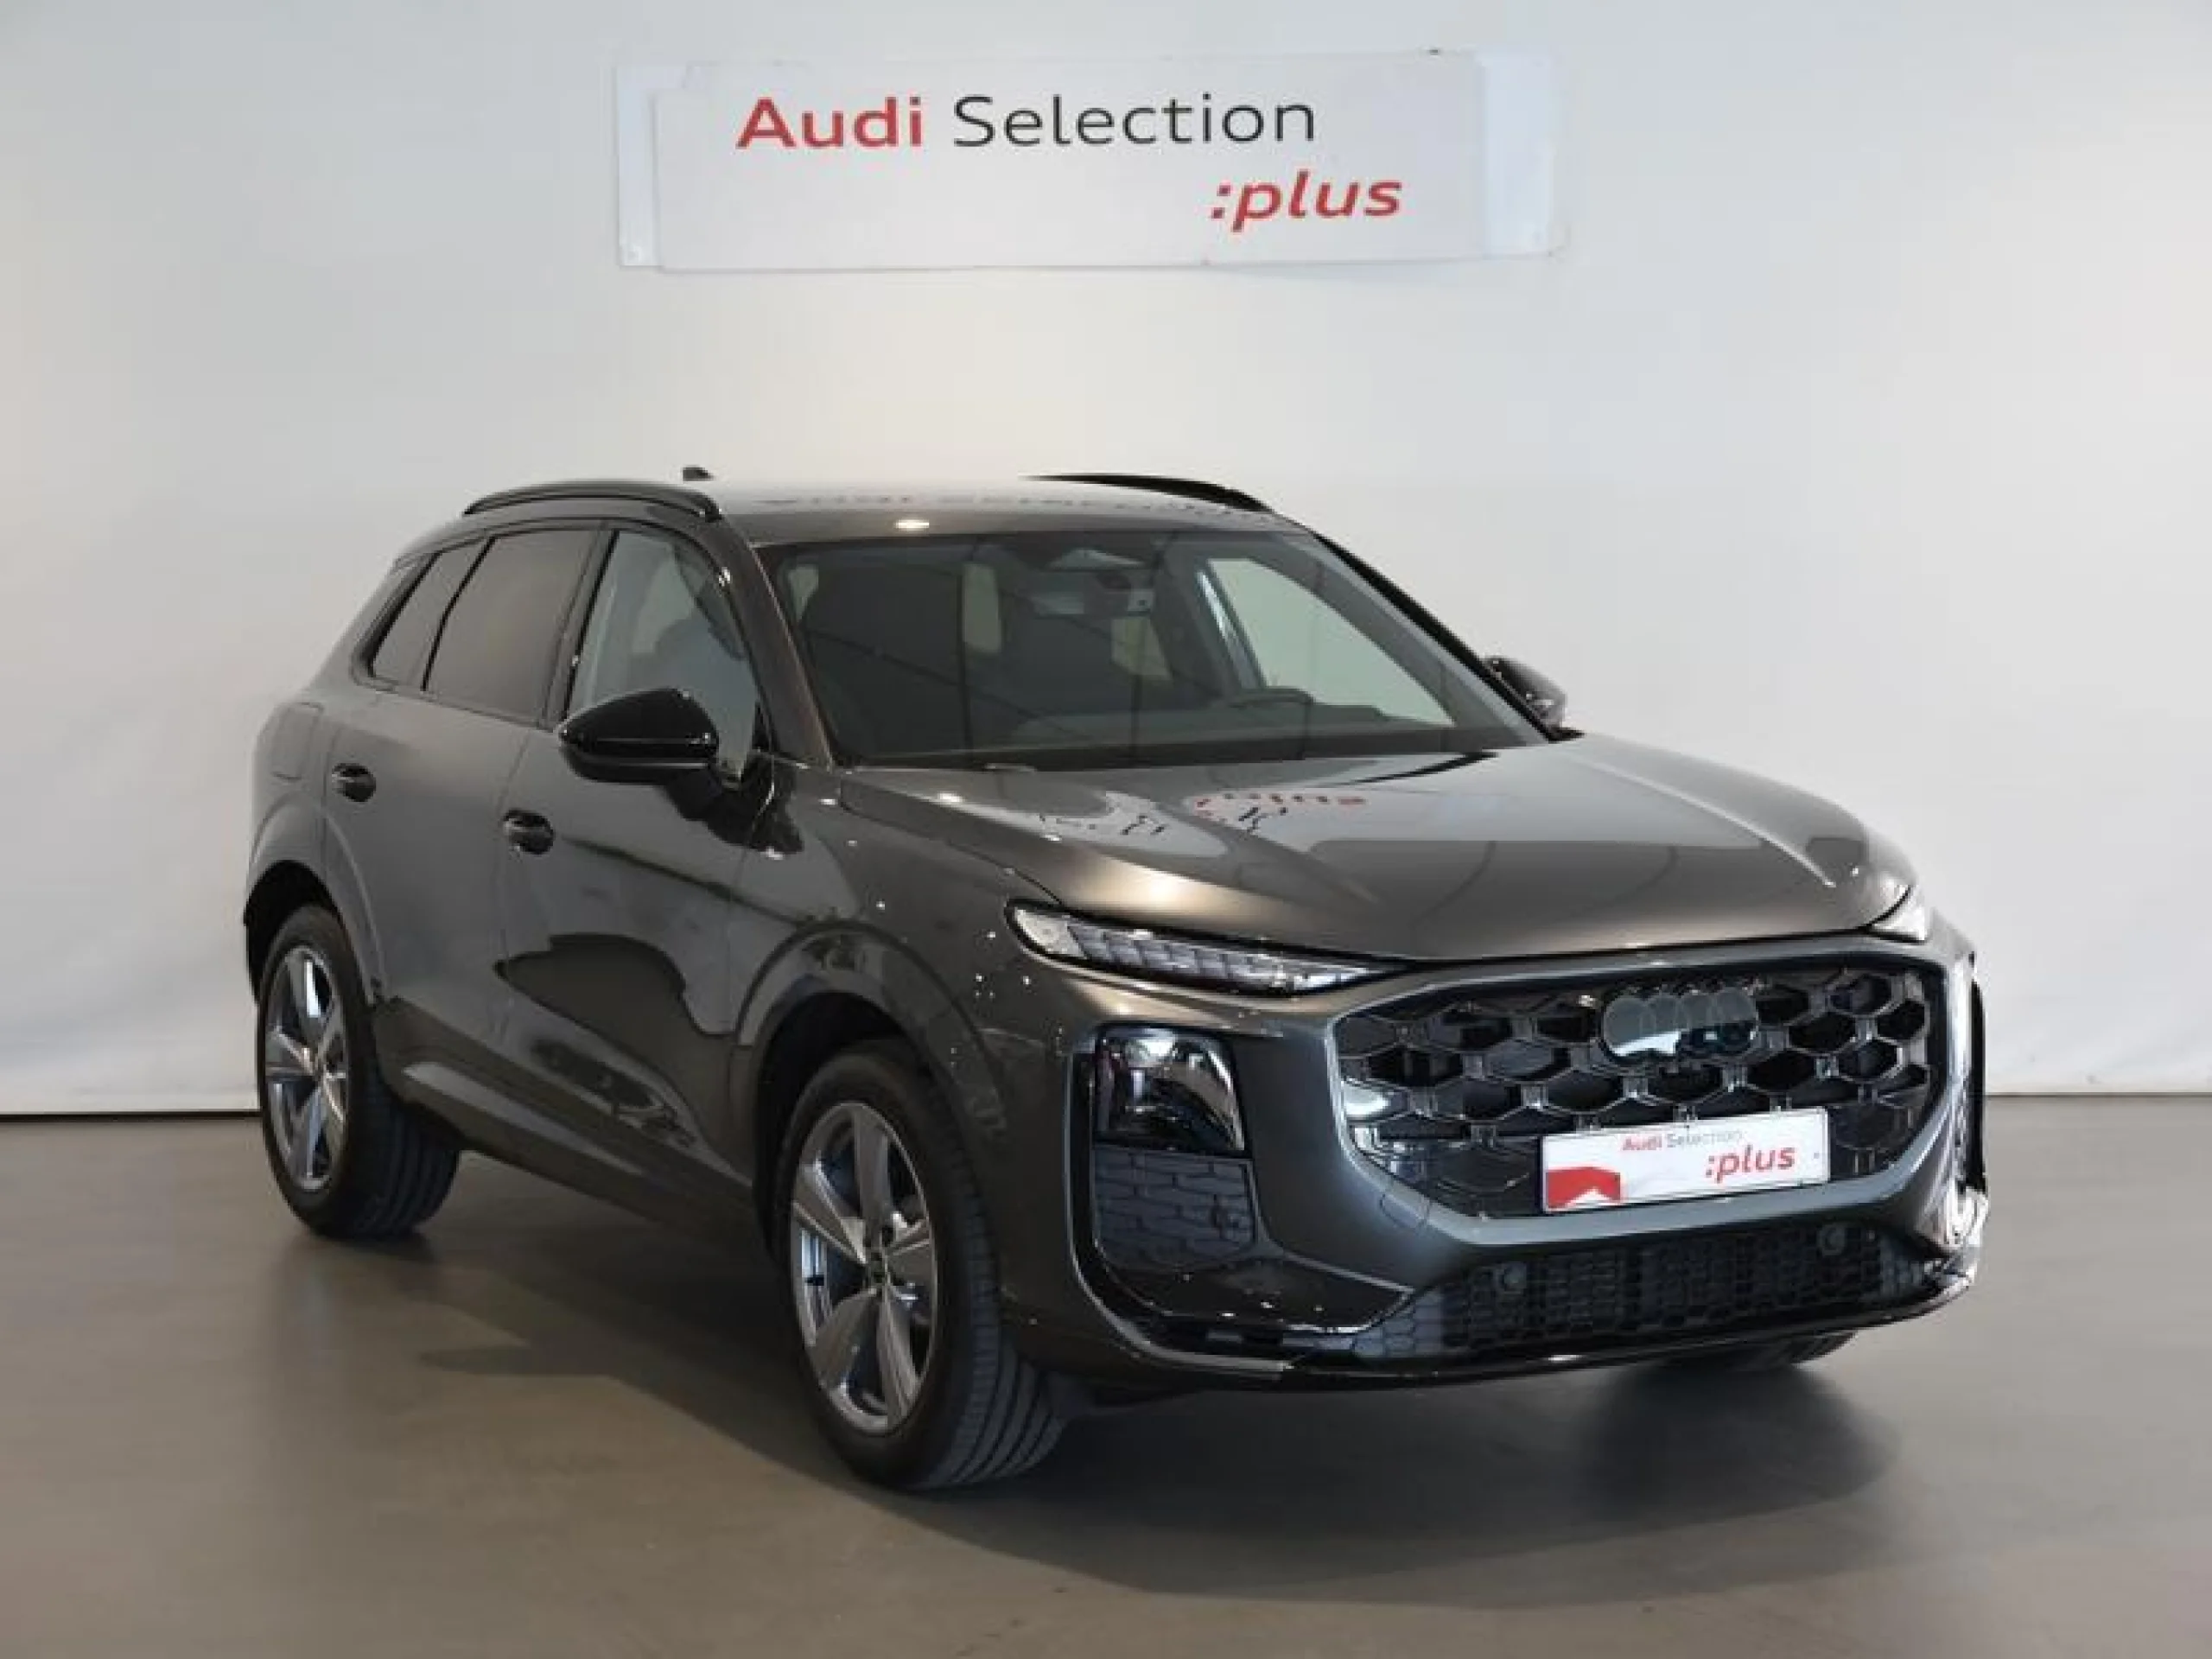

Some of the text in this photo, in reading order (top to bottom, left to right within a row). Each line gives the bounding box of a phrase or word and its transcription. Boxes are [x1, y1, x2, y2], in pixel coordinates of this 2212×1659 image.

[737, 92, 1316, 149] Audi Selection
[1211, 170, 1403, 232] :plus
[1622, 1134, 1662, 1151] Audi
[1706, 1143, 1796, 1184] :plus
